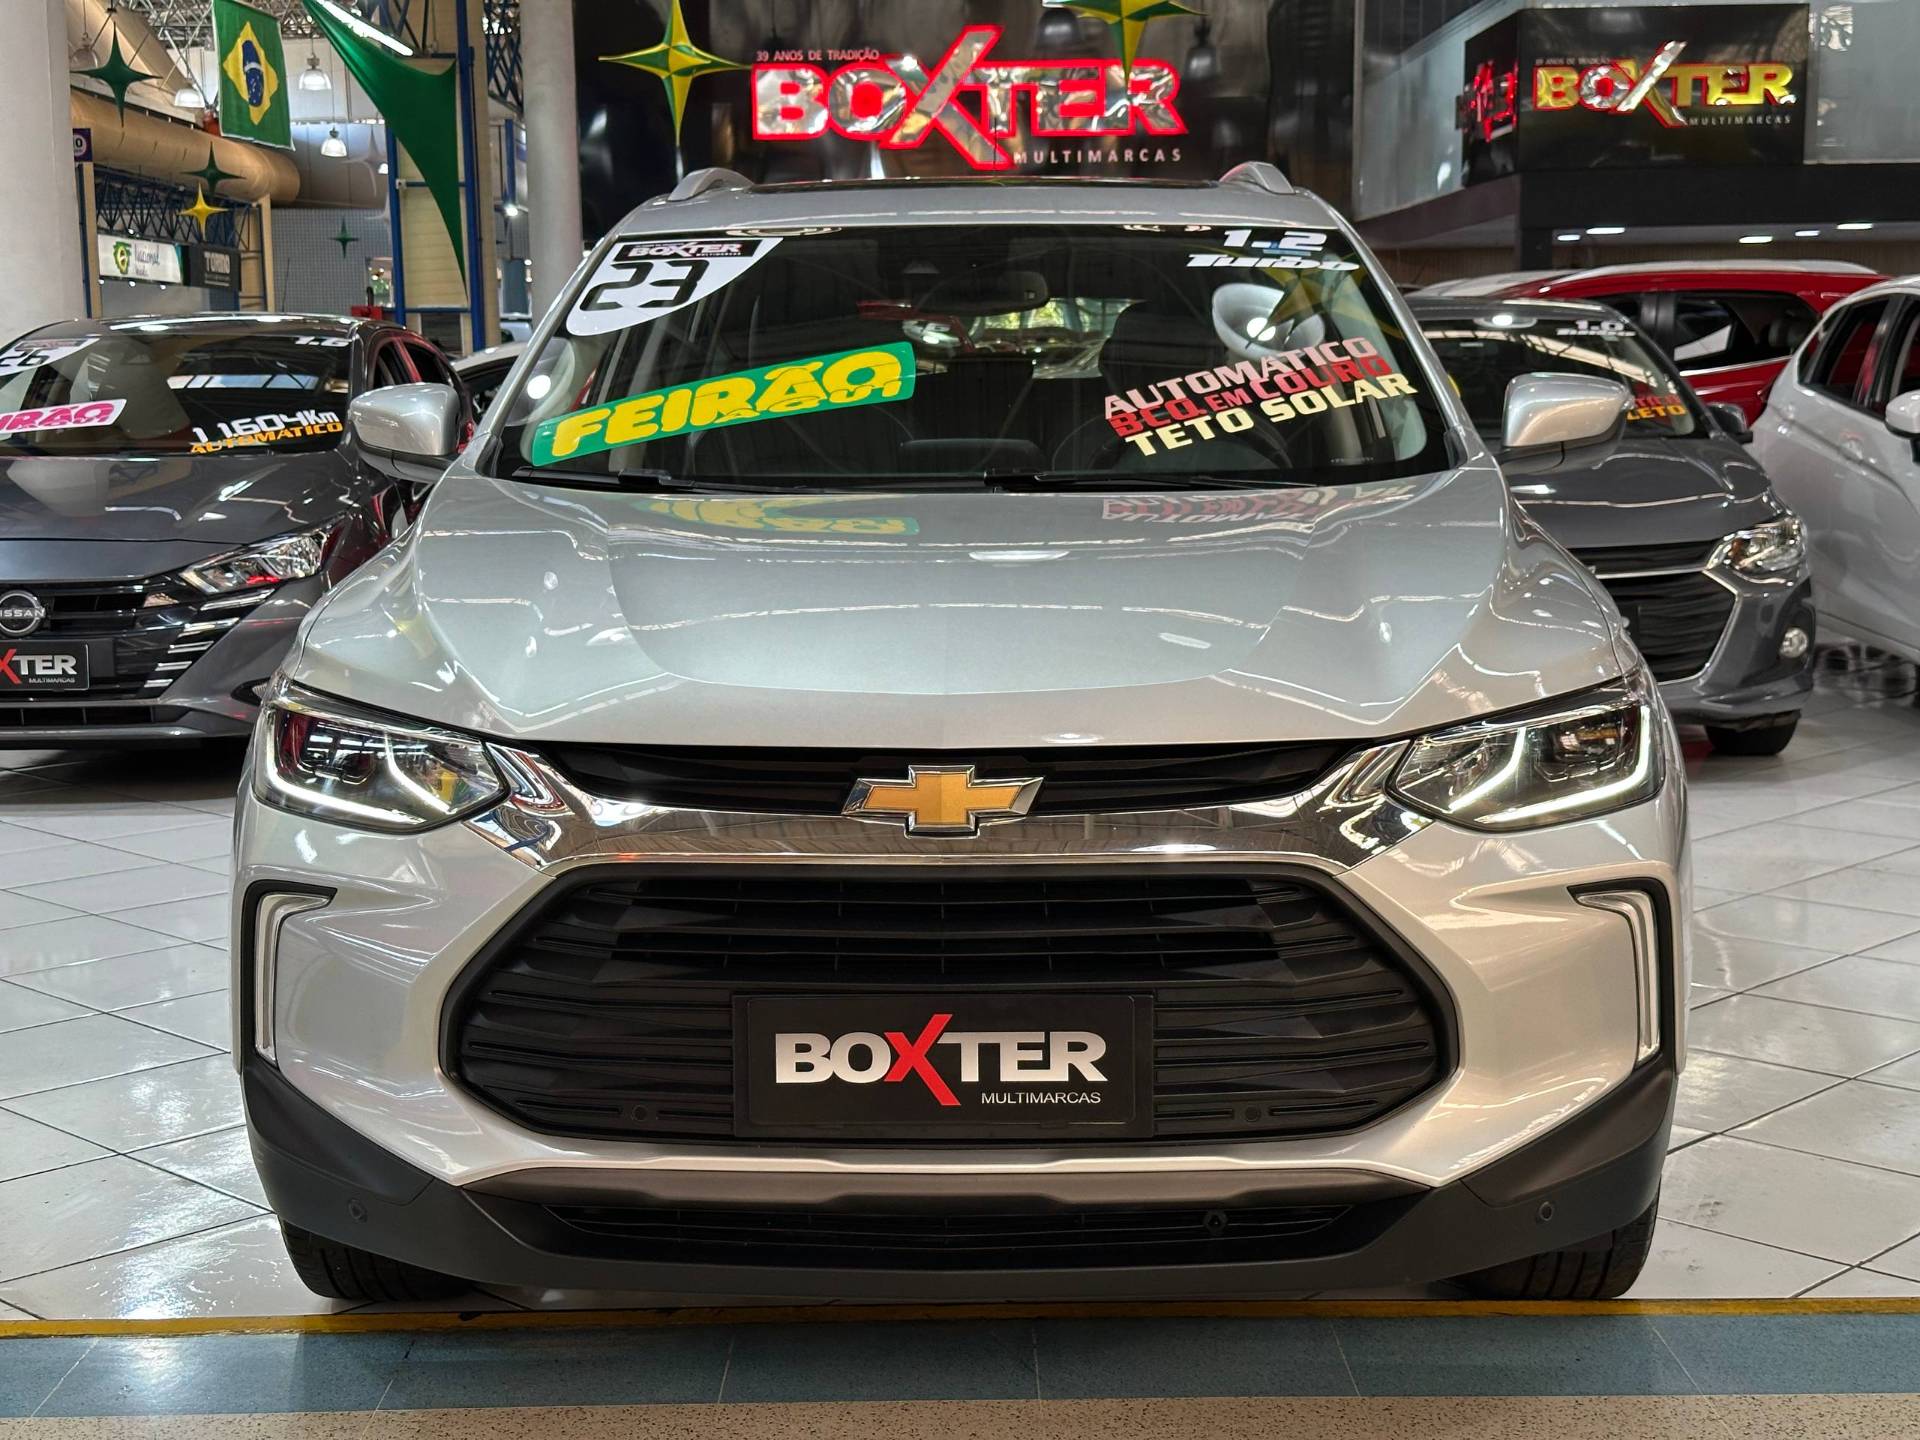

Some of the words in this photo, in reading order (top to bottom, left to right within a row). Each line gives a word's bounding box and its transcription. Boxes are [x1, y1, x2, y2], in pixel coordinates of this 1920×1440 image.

[774, 50, 804, 61] ANOS
[808, 50, 822, 61] DE
[827, 47, 880, 61] TRADIÇÃO
[751, 24, 1189, 171] BOXTER
[1533, 40, 1797, 128] BOXTER
[1690, 113, 1791, 126] MULTIMARCAS
[1013, 147, 1183, 165] MULTIMARCAS
[627, 241, 744, 257] BOXTER
[1224, 229, 1327, 251] 1.2
[1186, 254, 1360, 271] Turbo
[579, 260, 710, 312] 23
[1575, 319, 1625, 331] 1.0
[1104, 337, 1378, 420] AUTOMATICO
[1209, 390, 1253, 412] EM
[1249, 357, 1394, 401] COURO
[551, 350, 903, 457] FEIRÃO
[1125, 407, 1255, 456] TETO
[1259, 373, 1418, 423] SOLAR
[189, 422, 344, 454] AUTOMATICO
[775, 1013, 1108, 1106] BOXTER
[981, 1092, 1101, 1104] MULTIMARCAS
